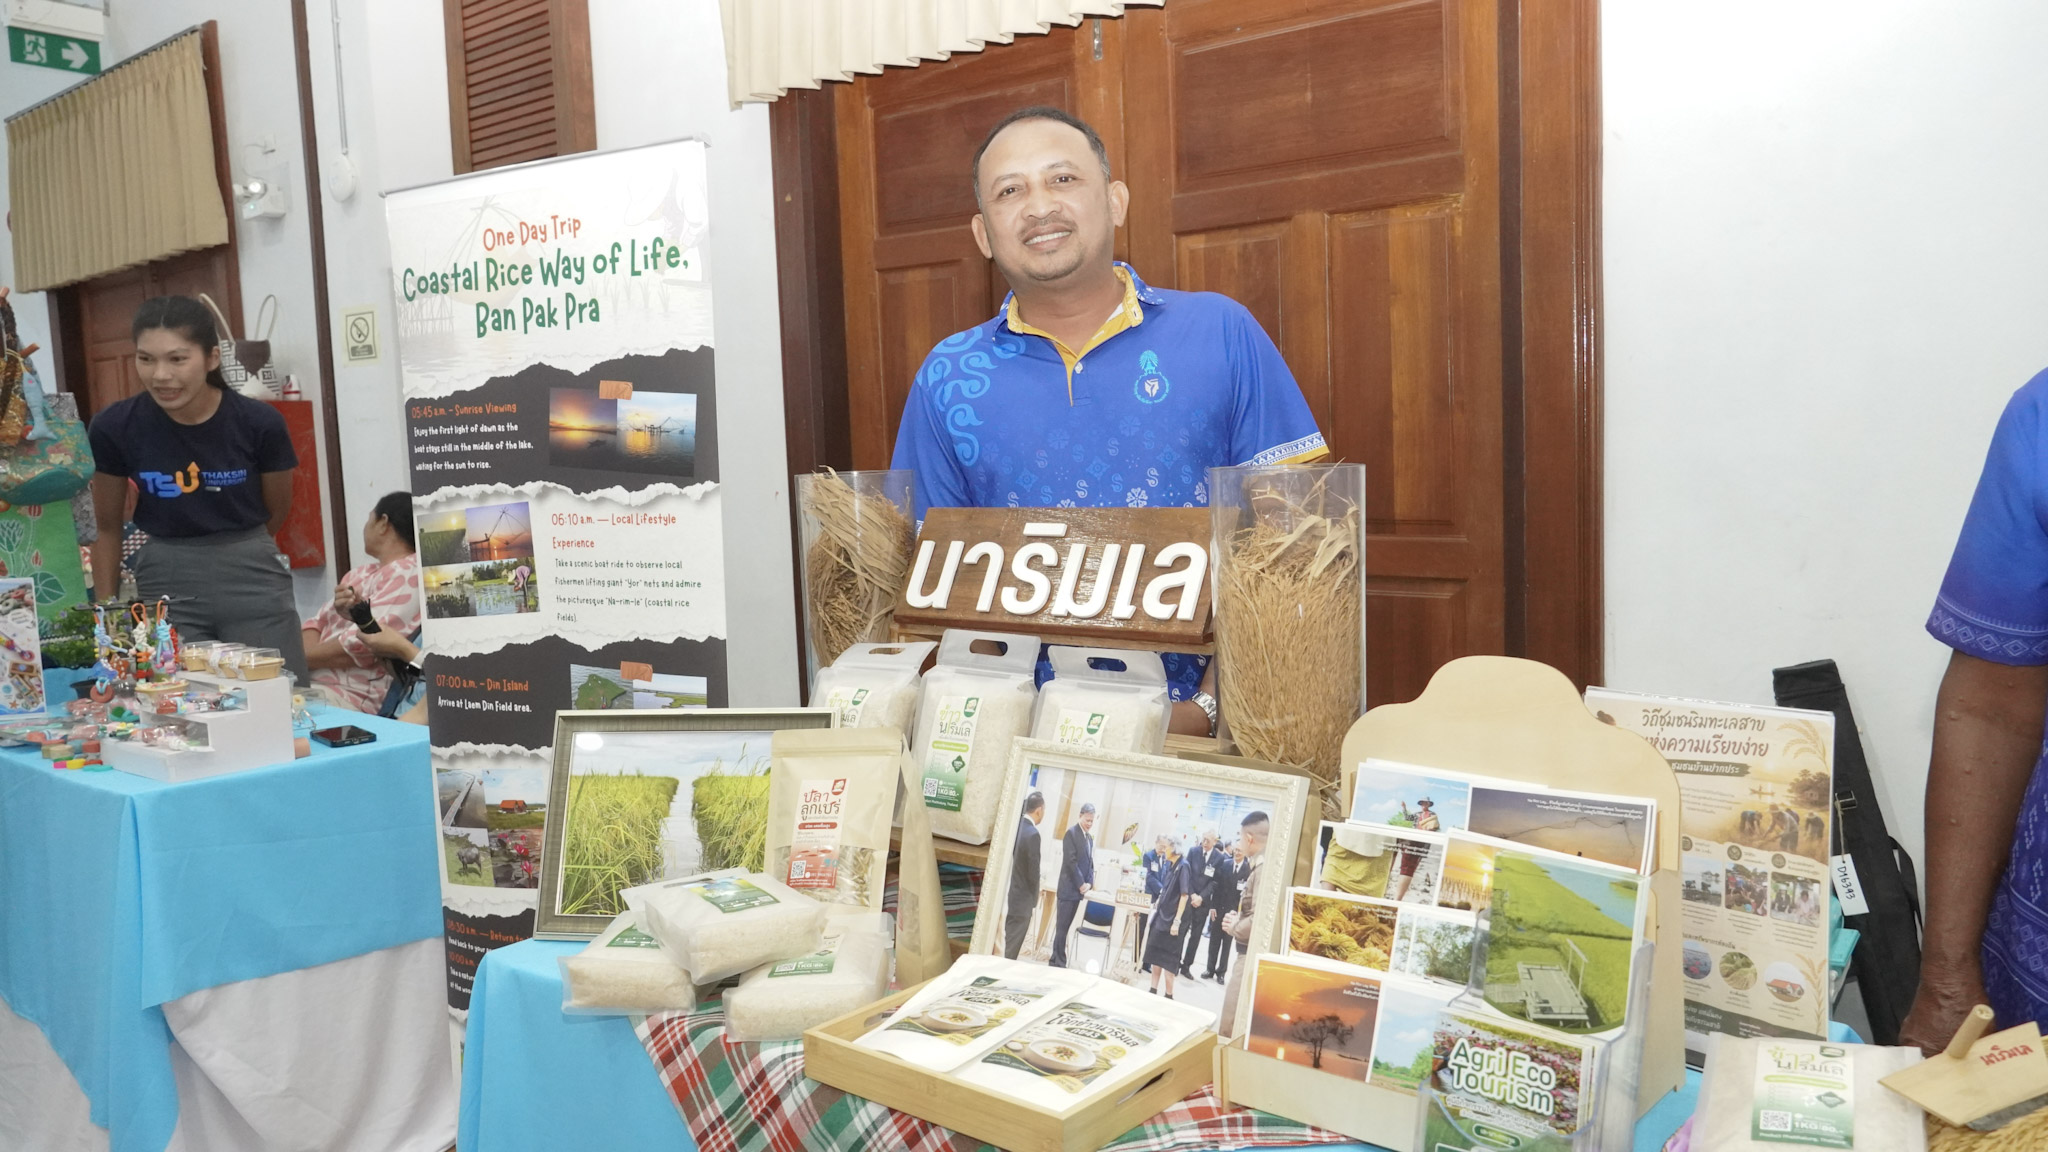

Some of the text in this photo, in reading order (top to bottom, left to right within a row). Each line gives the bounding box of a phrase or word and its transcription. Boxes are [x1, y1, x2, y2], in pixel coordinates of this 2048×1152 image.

[483, 215, 581, 251] One Day Trip
[403, 236, 689, 302] Coastal Rice Way of Life,
[475, 292, 600, 338] Ban Pak Pra
[411, 405, 433, 419] 05:45
[433, 407, 447, 416] a.m.
[455, 404, 483, 417] Sunrise
[485, 402, 517, 414] Viewing
[413, 422, 519, 437] Enjoy the first light of dawn as the
[414, 439, 534, 454] boat stays still in the middle of the lake.
[433, 461, 444, 471] for
[443, 460, 455, 470] the
[455, 461, 467, 469] sun
[467, 460, 475, 469] to
[139, 461, 200, 498] TSU
[201, 469, 247, 479] THAKSIN
[551, 513, 579, 526] 06:10
[580, 515, 595, 525] a.m.
[611, 513, 634, 526] Local
[635, 512, 677, 526] Lifestyle
[552, 536, 595, 550] Experience
[555, 558, 569, 568] Take
[574, 560, 593, 568] scenic
[594, 559, 609, 569] boat
[610, 560, 624, 568] ride
[626, 560, 634, 569] to
[635, 560, 663, 569] observe
[665, 560, 683, 569] local
[555, 576, 585, 586] fishermen
[585, 577, 606, 588] lifting
[606, 578, 623, 588] giant
[643, 579, 660, 588] nets
[661, 579, 674, 588] and
[675, 580, 702, 589] admire
[556, 595, 567, 604] the
[567, 596, 604, 607] picturesque
[644, 598, 673, 608] (coastal
[674, 599, 690, 607] rice
[436, 674, 461, 689] 07:00
[462, 679, 478, 689] a.m.
[486, 678, 501, 691] Din
[502, 679, 529, 692] Island
[437, 695, 533, 713] Arrive at Laem Din Field area.
[939, 704, 961, 723] ข้าว
[1642, 708, 1766, 732] วิถีชุมชนริมทะเลสาบ
[1644, 732, 1769, 757] ห่งความเรียบง่าย
[803, 789, 830, 803] ปลา
[490, 929, 514, 943] Return
[457, 939, 467, 949] back
[467, 942, 474, 950] to
[474, 945, 486, 953] your
[1453, 1041, 1552, 1086] Agri Eco
[1451, 1061, 1550, 1112] Tourism
